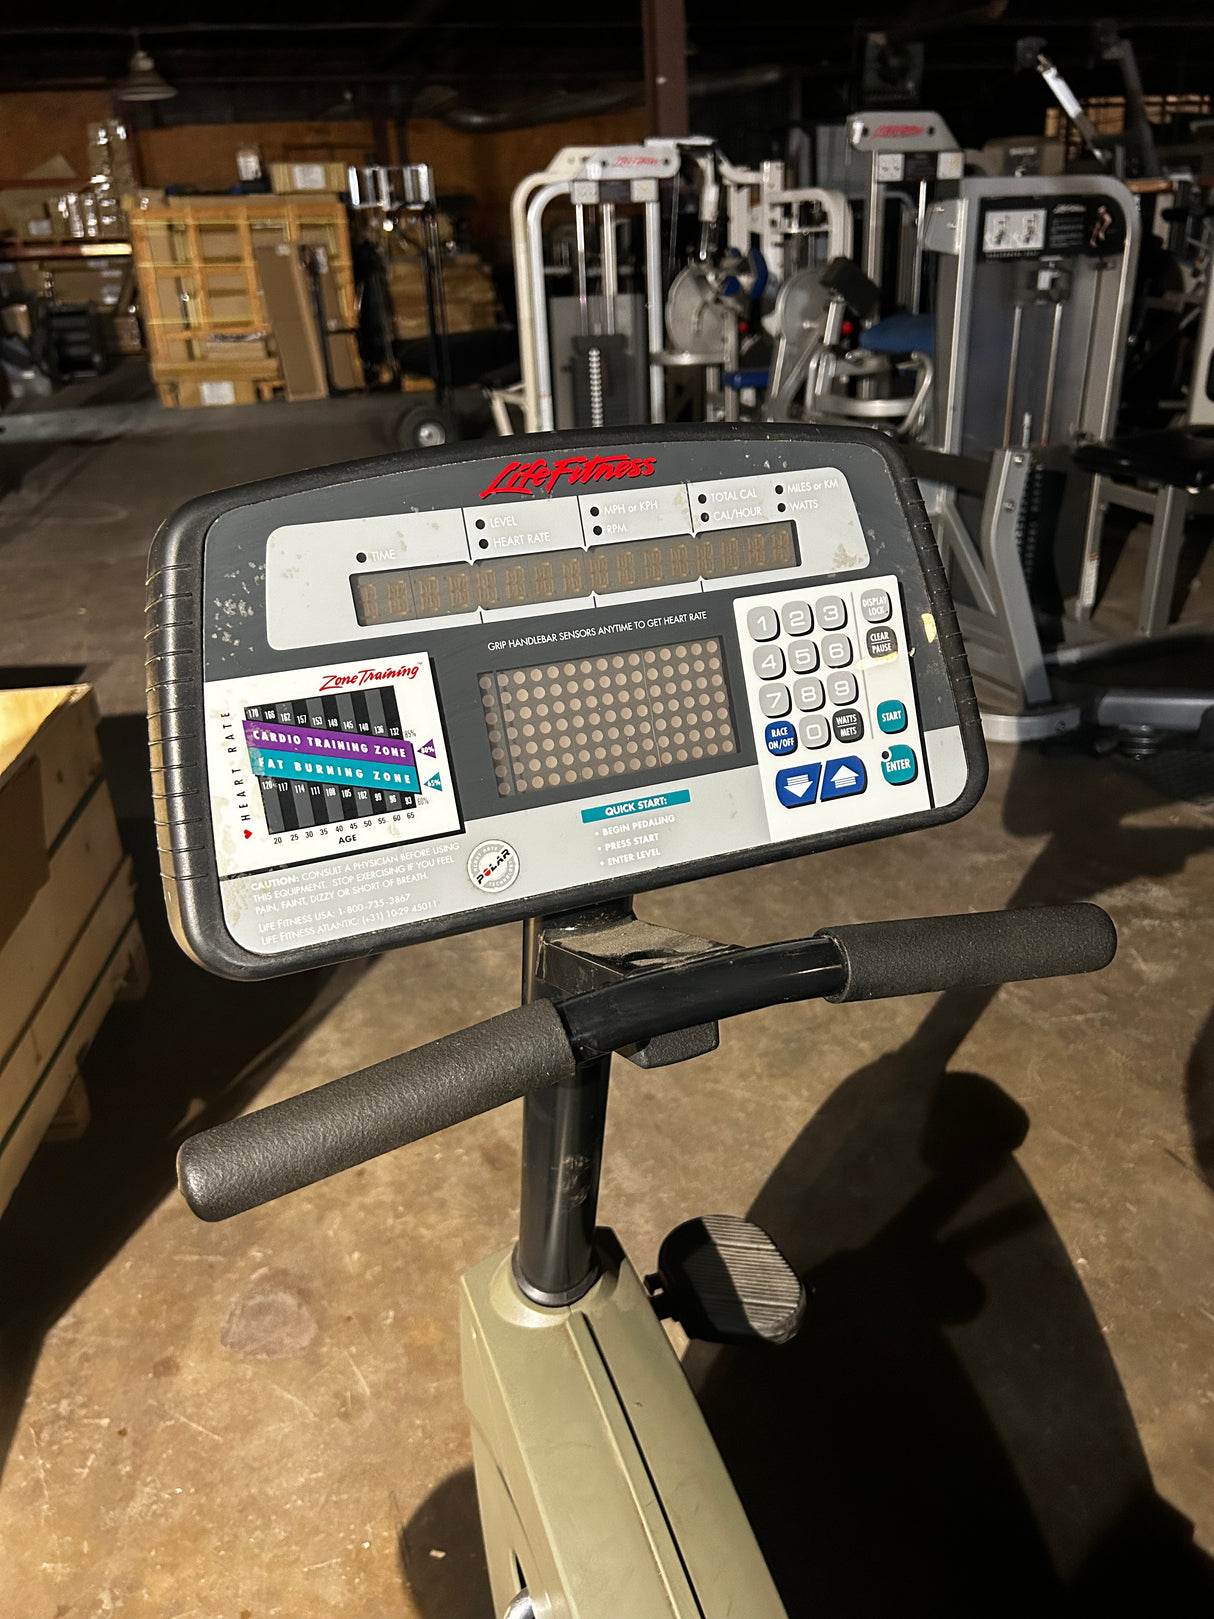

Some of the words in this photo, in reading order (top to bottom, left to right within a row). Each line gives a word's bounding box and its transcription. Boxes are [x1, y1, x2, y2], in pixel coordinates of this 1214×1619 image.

[788, 483, 811, 493] MILES
[813, 482, 822, 491] or
[824, 479, 839, 489] KM
[711, 491, 737, 501] TOTAL
[741, 488, 757, 498] CAL
[604, 504, 625, 515] MPH
[628, 503, 637, 512] or
[640, 500, 658, 511] KPH
[790, 500, 819, 511] WATTS
[489, 516, 517, 528] LEVEL
[713, 507, 762, 521] CAL/HOUR
[607, 524, 627, 535] RPM
[493, 534, 525, 548] HEART
[528, 531, 550, 544] RATE
[371, 549, 396, 561] TIME
[862, 595, 888, 608] DISPLAY
[789, 610, 806, 627] 2
[823, 605, 839, 621] 3
[868, 607, 885, 616] LOCK
[487, 639, 507, 651] GRIP
[508, 631, 558, 648] HANDLEBAR
[559, 627, 596, 641] SENSORS
[598, 622, 633, 636] ANYTIME
[633, 620, 646, 630] TO
[647, 617, 662, 628] GET
[663, 614, 688, 626] HEART
[689, 610, 707, 621] RATE
[757, 615, 767, 631] 1
[870, 631, 890, 641] CLEAR
[795, 648, 811, 664] 5
[828, 642, 844, 659] 6
[871, 643, 892, 654] PAUSE
[761, 654, 777, 670] 4
[319, 674, 358, 692] Zone
[357, 665, 420, 686] Training
[801, 686, 817, 703] 8
[834, 680, 850, 697] 9
[766, 692, 782, 709] 7
[836, 713, 857, 725] WATTS
[881, 710, 902, 723] START
[220, 712, 238, 754] RATE
[296, 714, 307, 725] 157
[312, 716, 323, 726] 153
[342, 720, 354, 730] 145
[389, 727, 400, 736] 132
[771, 726, 789, 738] RACE
[840, 726, 857, 738] METS
[252, 730, 302, 745] CARDIO
[306, 736, 369, 753] TRAINING
[374, 745, 407, 758] ZONE
[768, 737, 795, 751] ON/OFF
[257, 756, 284, 770] FAT
[293, 761, 364, 779] BURNING
[372, 770, 412, 784] ZONE
[886, 758, 911, 773] ENTER
[231, 768, 251, 822] HEART
[277, 782, 289, 792] 117
[294, 784, 306, 794] 114
[310, 786, 321, 796] 111
[605, 802, 637, 817] QUICK
[637, 797, 669, 810] START:
[273, 836, 283, 845] 20
[290, 833, 299, 841] 25
[305, 830, 314, 838] 30
[319, 827, 329, 836] 35
[335, 825, 344, 833] 40
[349, 822, 358, 830] 45
[363, 819, 373, 828] 50
[377, 816, 387, 825] 55
[392, 814, 401, 822] 60
[406, 811, 415, 819] 65
[602, 824, 631, 837] BEGIN
[632, 814, 676, 831] PEDALING
[338, 834, 357, 845] AGE
[605, 840, 632, 852] PRESS
[633, 833, 660, 845] START
[607, 854, 635, 867] ENTER
[636, 847, 661, 860] LEVEL
[251, 876, 299, 891] CAUTION:
[301, 865, 342, 881] CONSULT
[345, 864, 352, 872] A
[353, 855, 399, 871] PHYSICIAN
[400, 847, 431, 861] BEFORE
[432, 842, 460, 855] USING
[253, 891, 273, 903] THIS
[332, 875, 354, 887] STOP
[356, 865, 406, 882] EXERCISING
[407, 863, 415, 872] IF
[416, 859, 435, 869] YOU
[436, 855, 455, 866] FEEL
[256, 903, 280, 915] PAIN,
[310, 890, 334, 903] DIZZY
[336, 888, 351, 898] OR
[352, 882, 381, 895] SHORT
[382, 879, 395, 888] OF
[258, 922, 276, 934] LIFE
[277, 914, 313, 929] FITNESS
[261, 934, 279, 946] LIFE
[280, 926, 316, 942] FITNESS
